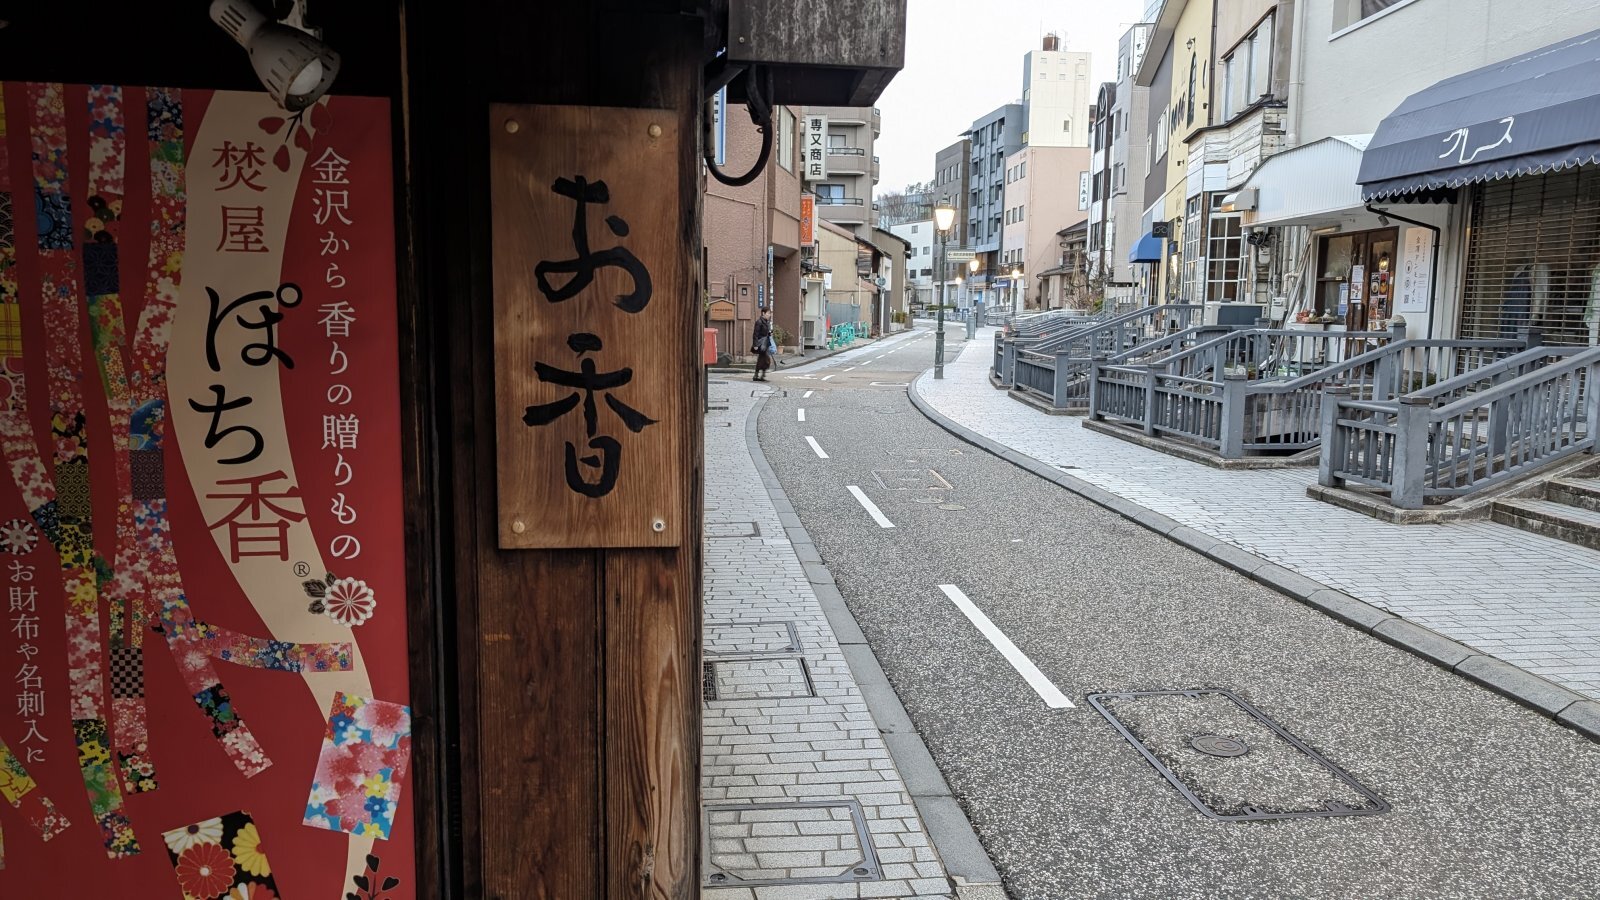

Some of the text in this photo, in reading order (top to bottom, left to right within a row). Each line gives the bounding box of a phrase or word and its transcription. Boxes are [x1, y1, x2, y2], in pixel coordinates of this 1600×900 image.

[809, 118, 823, 177] 専又商店
[522, 175, 659, 498] お香
[7, 558, 50, 764] お財布や名刺入に
